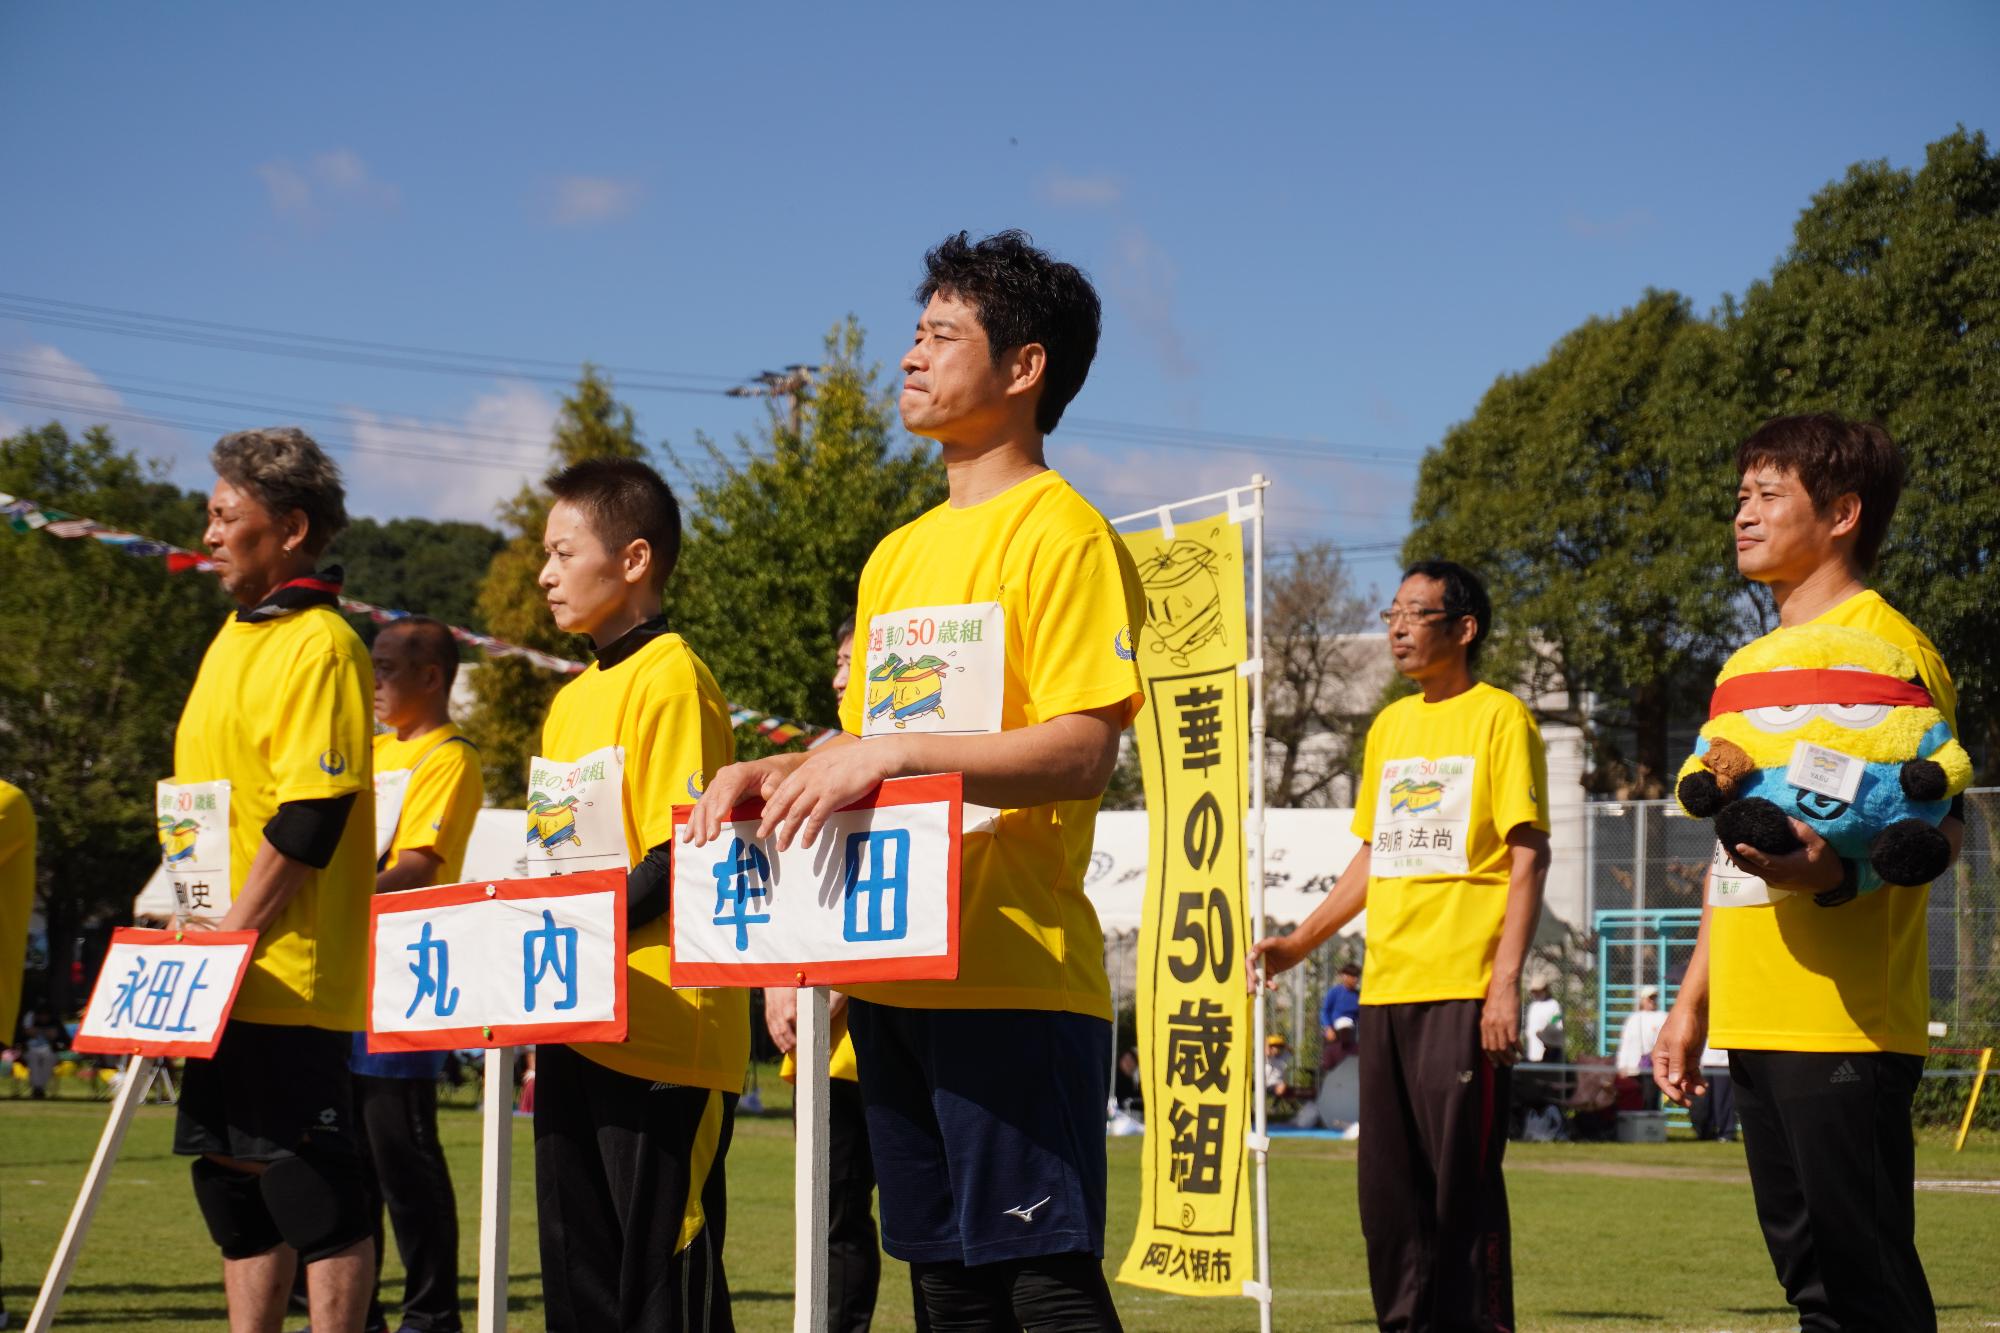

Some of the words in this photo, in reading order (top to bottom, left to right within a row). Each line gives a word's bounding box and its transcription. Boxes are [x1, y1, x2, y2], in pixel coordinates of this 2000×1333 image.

[885, 617, 983, 650] 華の50歳組
[1408, 826, 1452, 851] 法尚
[712, 827, 911, 951] 牟田
[404, 909, 579, 1021] 丸内
[1165, 683, 1234, 1194] 華の50歳組
[105, 955, 209, 1033] 永田上
[1140, 1242, 1232, 1284] 阿久根市
